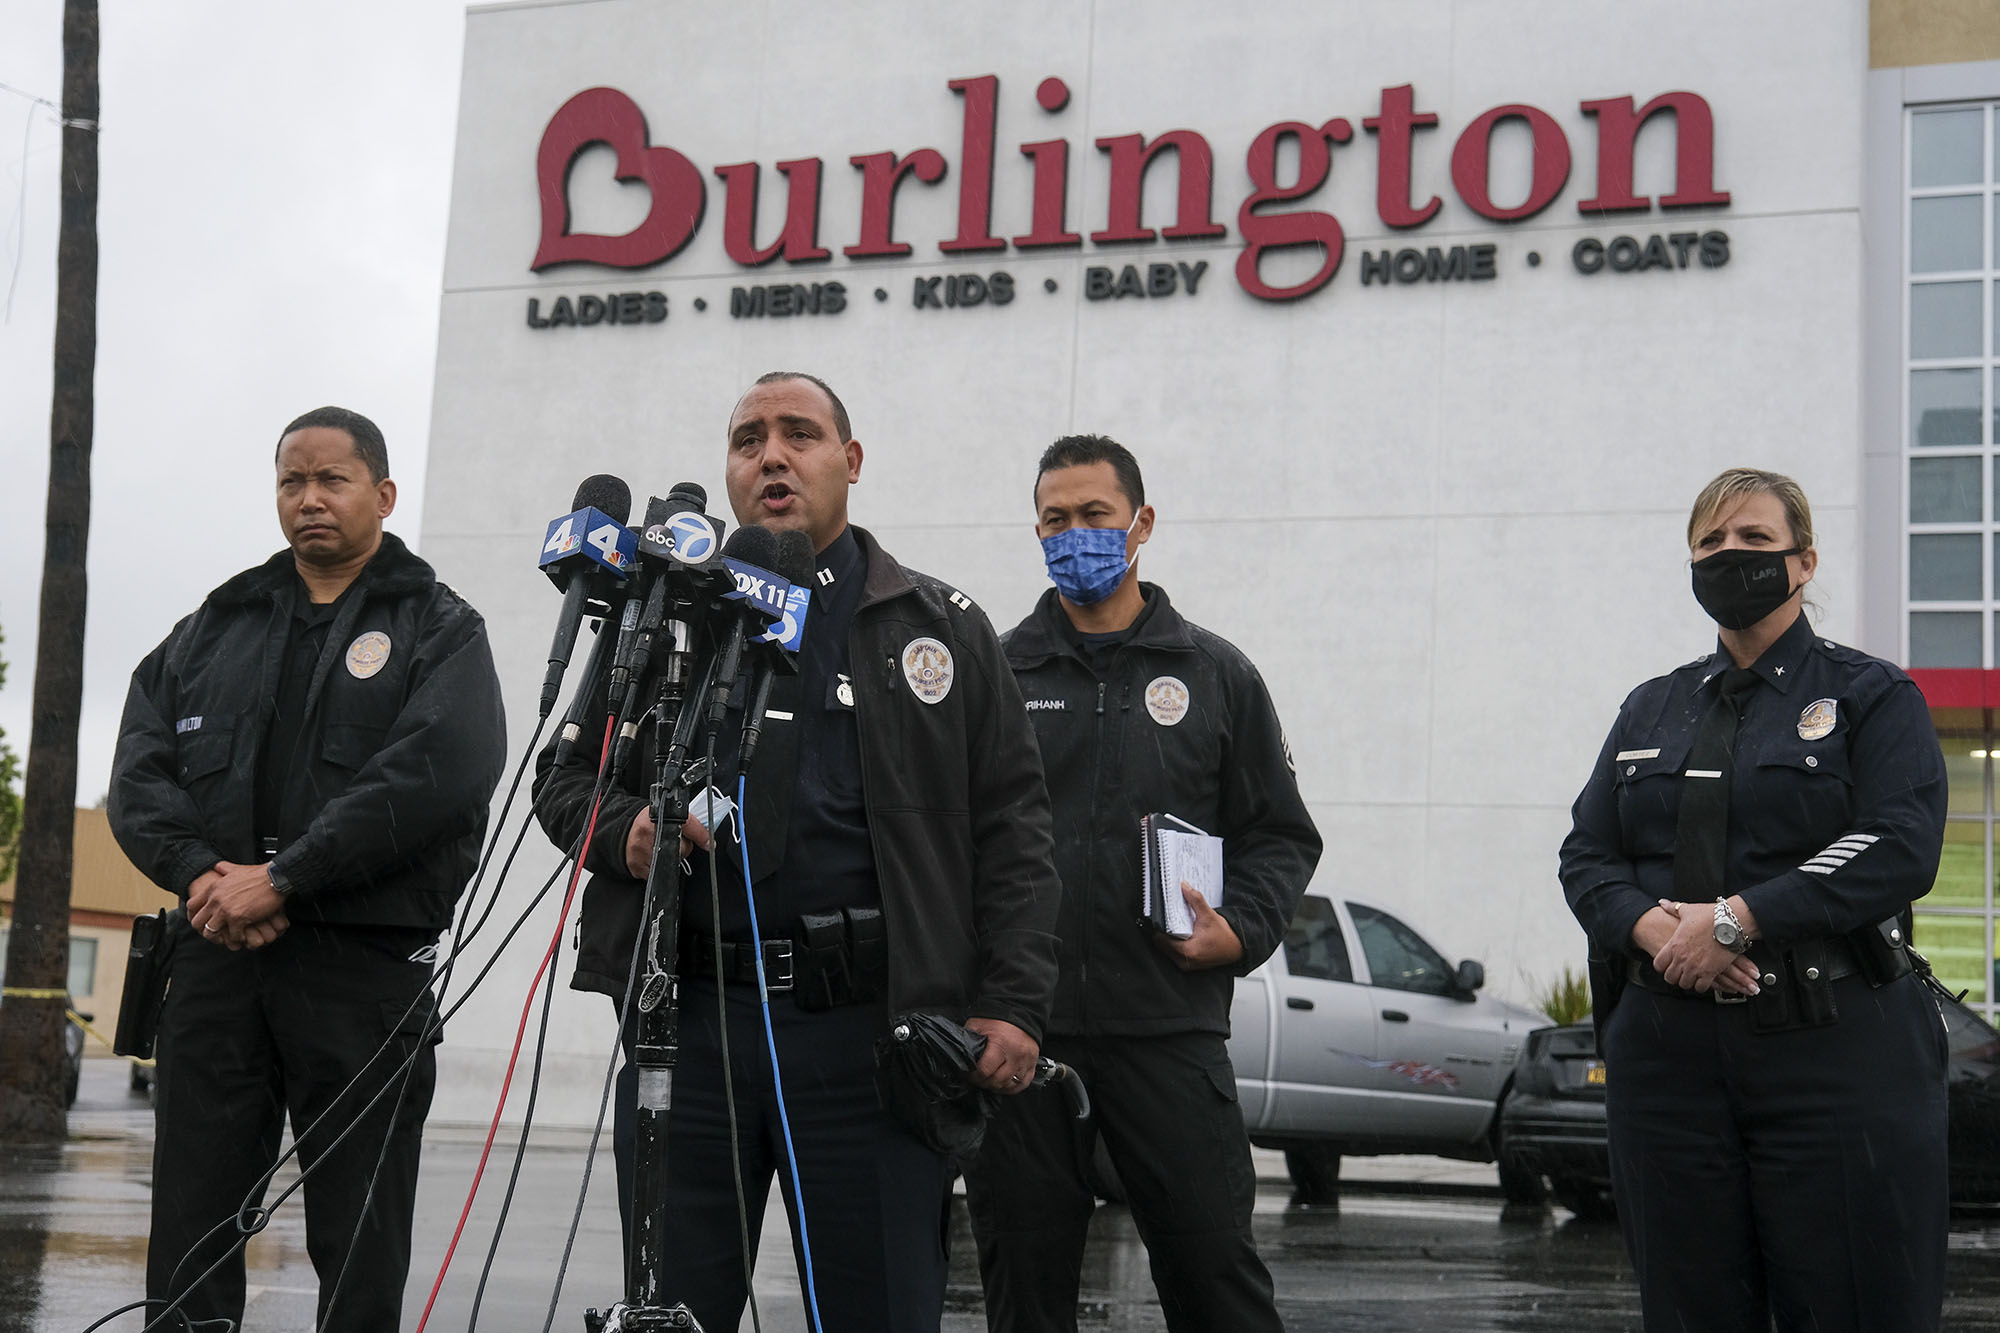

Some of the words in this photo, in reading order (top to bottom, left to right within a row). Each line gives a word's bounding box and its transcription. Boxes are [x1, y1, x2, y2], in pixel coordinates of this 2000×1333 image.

[531, 74, 1731, 301] Burlington
[527, 291, 668, 328] LADIES
[731, 282, 847, 319] MENS
[914, 272, 1015, 309] KIDS
[1085, 261, 1208, 300] BABY
[1361, 243, 1497, 286] HOME
[1573, 231, 1731, 274] COATS
[544, 517, 575, 555] 4
[587, 523, 621, 570] 4
[645, 531, 676, 548] abc
[729, 568, 767, 600] OX
[766, 584, 786, 609] 11
[1025, 699, 1065, 711] RIHANH
